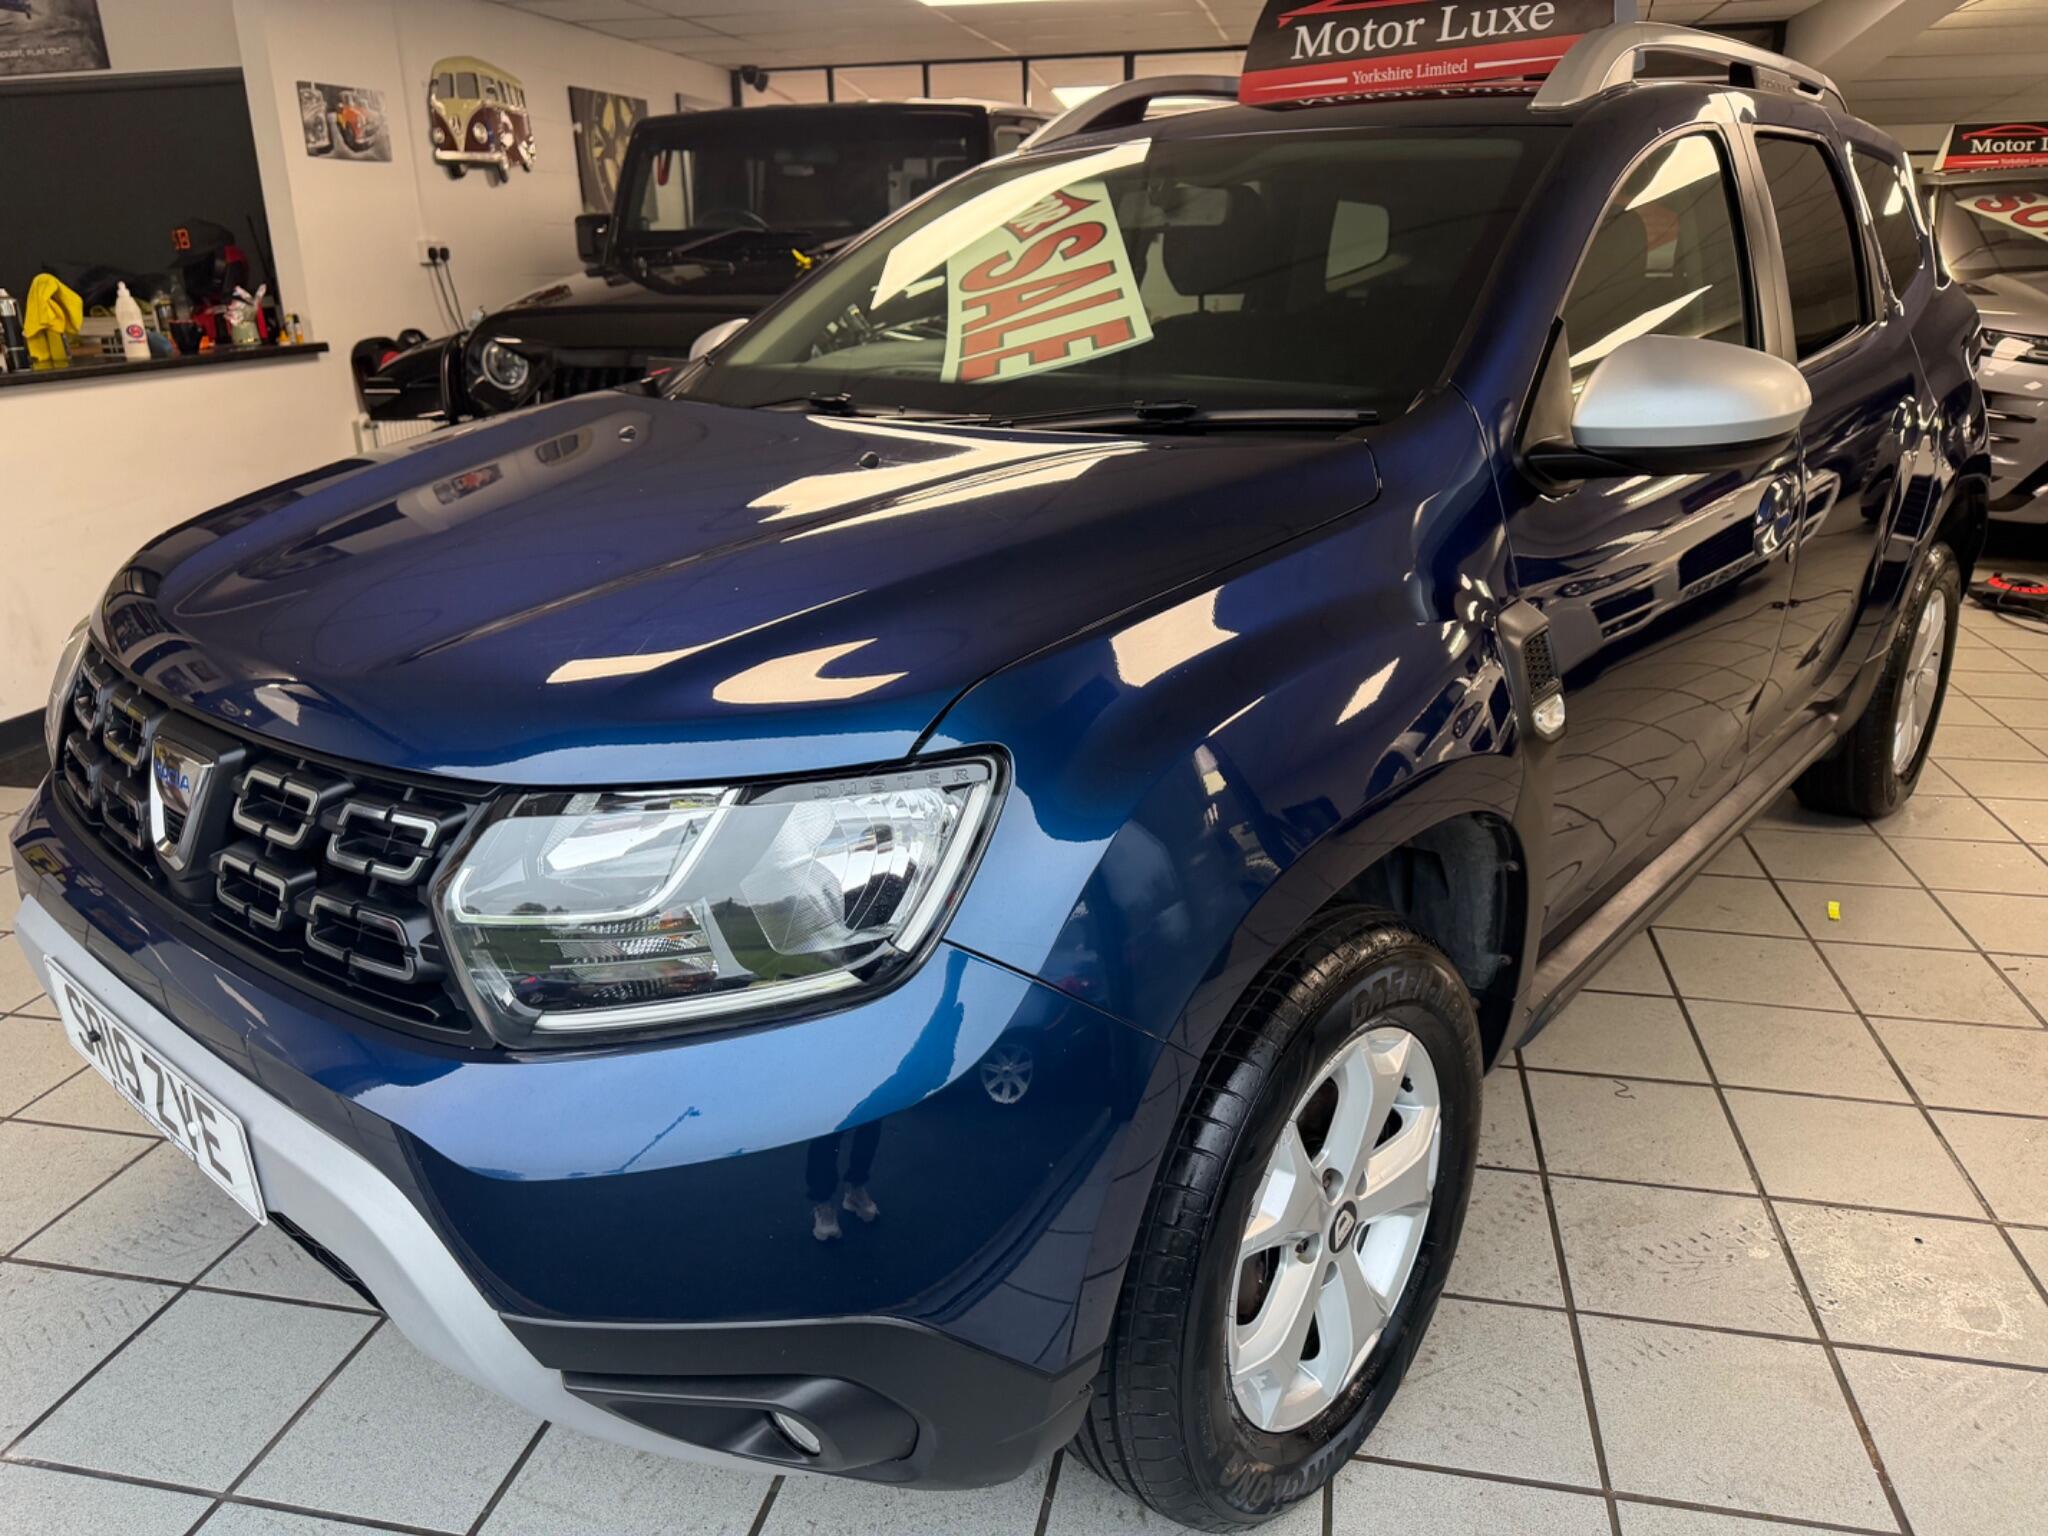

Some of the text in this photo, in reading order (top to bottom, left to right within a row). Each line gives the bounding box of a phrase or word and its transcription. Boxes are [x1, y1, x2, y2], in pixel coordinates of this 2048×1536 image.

[1290, 1, 1556, 60] Motor Luxe
[1352, 58, 1468, 86] Yorkshire Limited
[1970, 138, 2036, 153] Motor
[958, 220, 1136, 384] SALE
[813, 768, 970, 799] DUSTER
[64, 984, 146, 1105] SR19
[141, 1051, 233, 1186] ZVE
